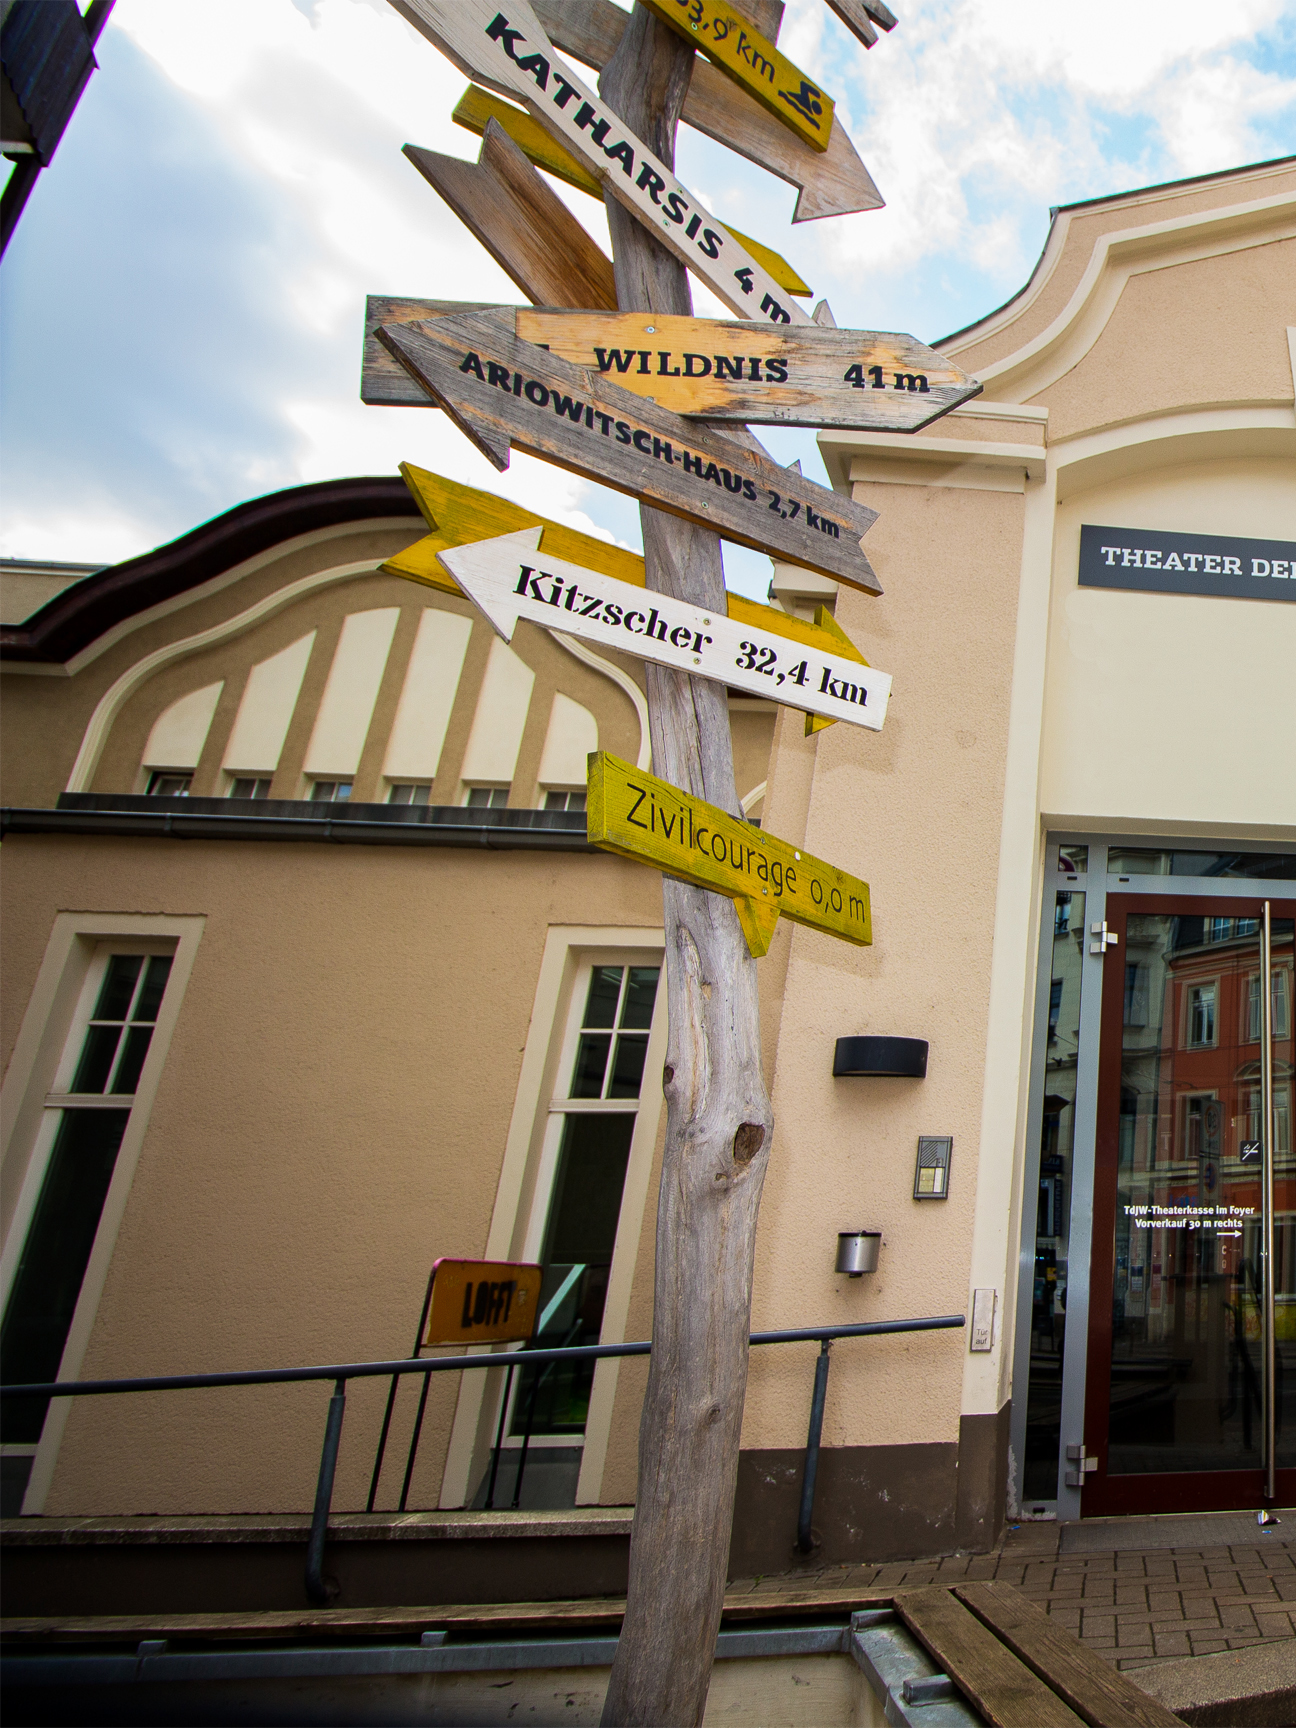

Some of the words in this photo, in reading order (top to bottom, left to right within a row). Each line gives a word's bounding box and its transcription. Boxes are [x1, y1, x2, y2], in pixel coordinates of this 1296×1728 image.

[676, 0, 728, 41] 3,9
[736, 30, 776, 84] km
[484, 12, 724, 261] KATHARSIS
[733, 266, 755, 296] 4
[759, 292, 792, 325] m
[593, 347, 789, 383] WILDNIS
[459, 351, 757, 501] ARIOWITSCH-HAUS
[769, 489, 802, 520] 2,7
[804, 505, 840, 539] km
[1100, 546, 1242, 576] THEATER
[512, 563, 713, 656] Kitzscher
[735, 640, 810, 688] 32,4
[817, 667, 869, 706] km
[626, 782, 797, 897] Zivilcourage
[849, 894, 866, 924] m
[1124, 1205, 1214, 1216] TdJW-Theaterkasse
[1215, 1205, 1228, 1215] im
[1229, 1205, 1255, 1217] Foyer
[1135, 1218, 1187, 1228] Vorverkauf
[1188, 1220, 1201, 1230] 30
[1203, 1220, 1212, 1228] m
[1213, 1218, 1243, 1228] rechts
[975, 1337, 988, 1345] auf
